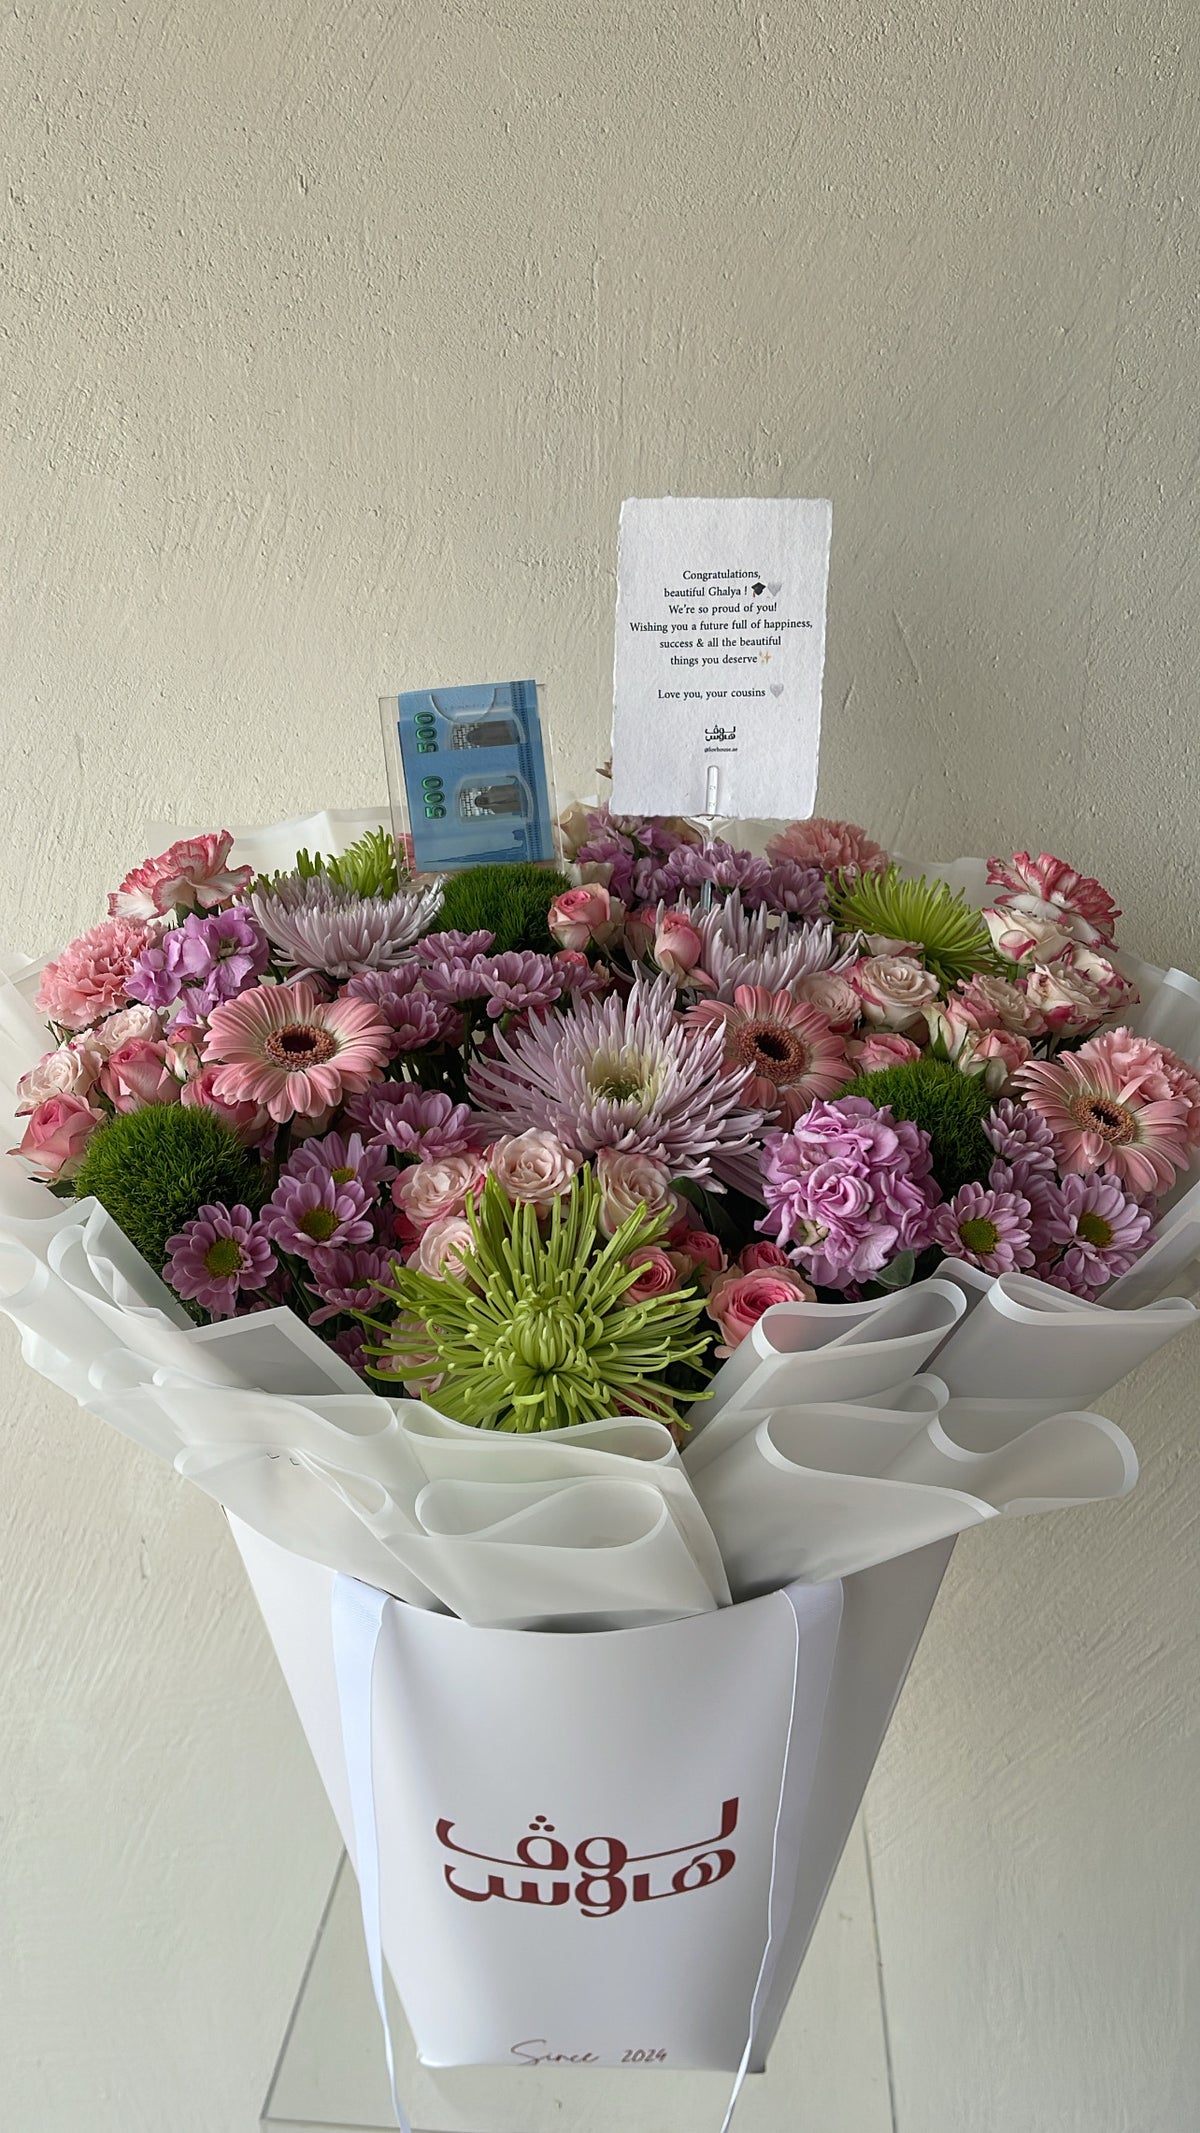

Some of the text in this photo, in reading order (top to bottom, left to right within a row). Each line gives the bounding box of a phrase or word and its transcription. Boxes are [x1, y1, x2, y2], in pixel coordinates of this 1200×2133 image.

[683, 569, 761, 581] Congratulations,
[664, 587, 705, 597] beautiful
[708, 586, 741, 598] Ghalya
[669, 604, 695, 614] We're
[712, 603, 740, 616] proud
[744, 602, 754, 612] of
[756, 602, 777, 615] you!
[630, 622, 668, 634] Wishing
[671, 624, 688, 633] you
[700, 620, 728, 630] future
[732, 619, 747, 629] full
[751, 619, 761, 629] of
[764, 619, 812, 631] happiness,
[696, 638, 704, 647] &
[707, 637, 718, 647] all
[722, 637, 736, 647] the
[740, 636, 781, 646] beautiful
[671, 654, 758, 667] things you deserve
[658, 688, 765, 701] Love you, your cousins
[414, 711, 439, 753] 500
[421, 775, 447, 820] 500
[510, 2039, 667, 2066] Since 2024
